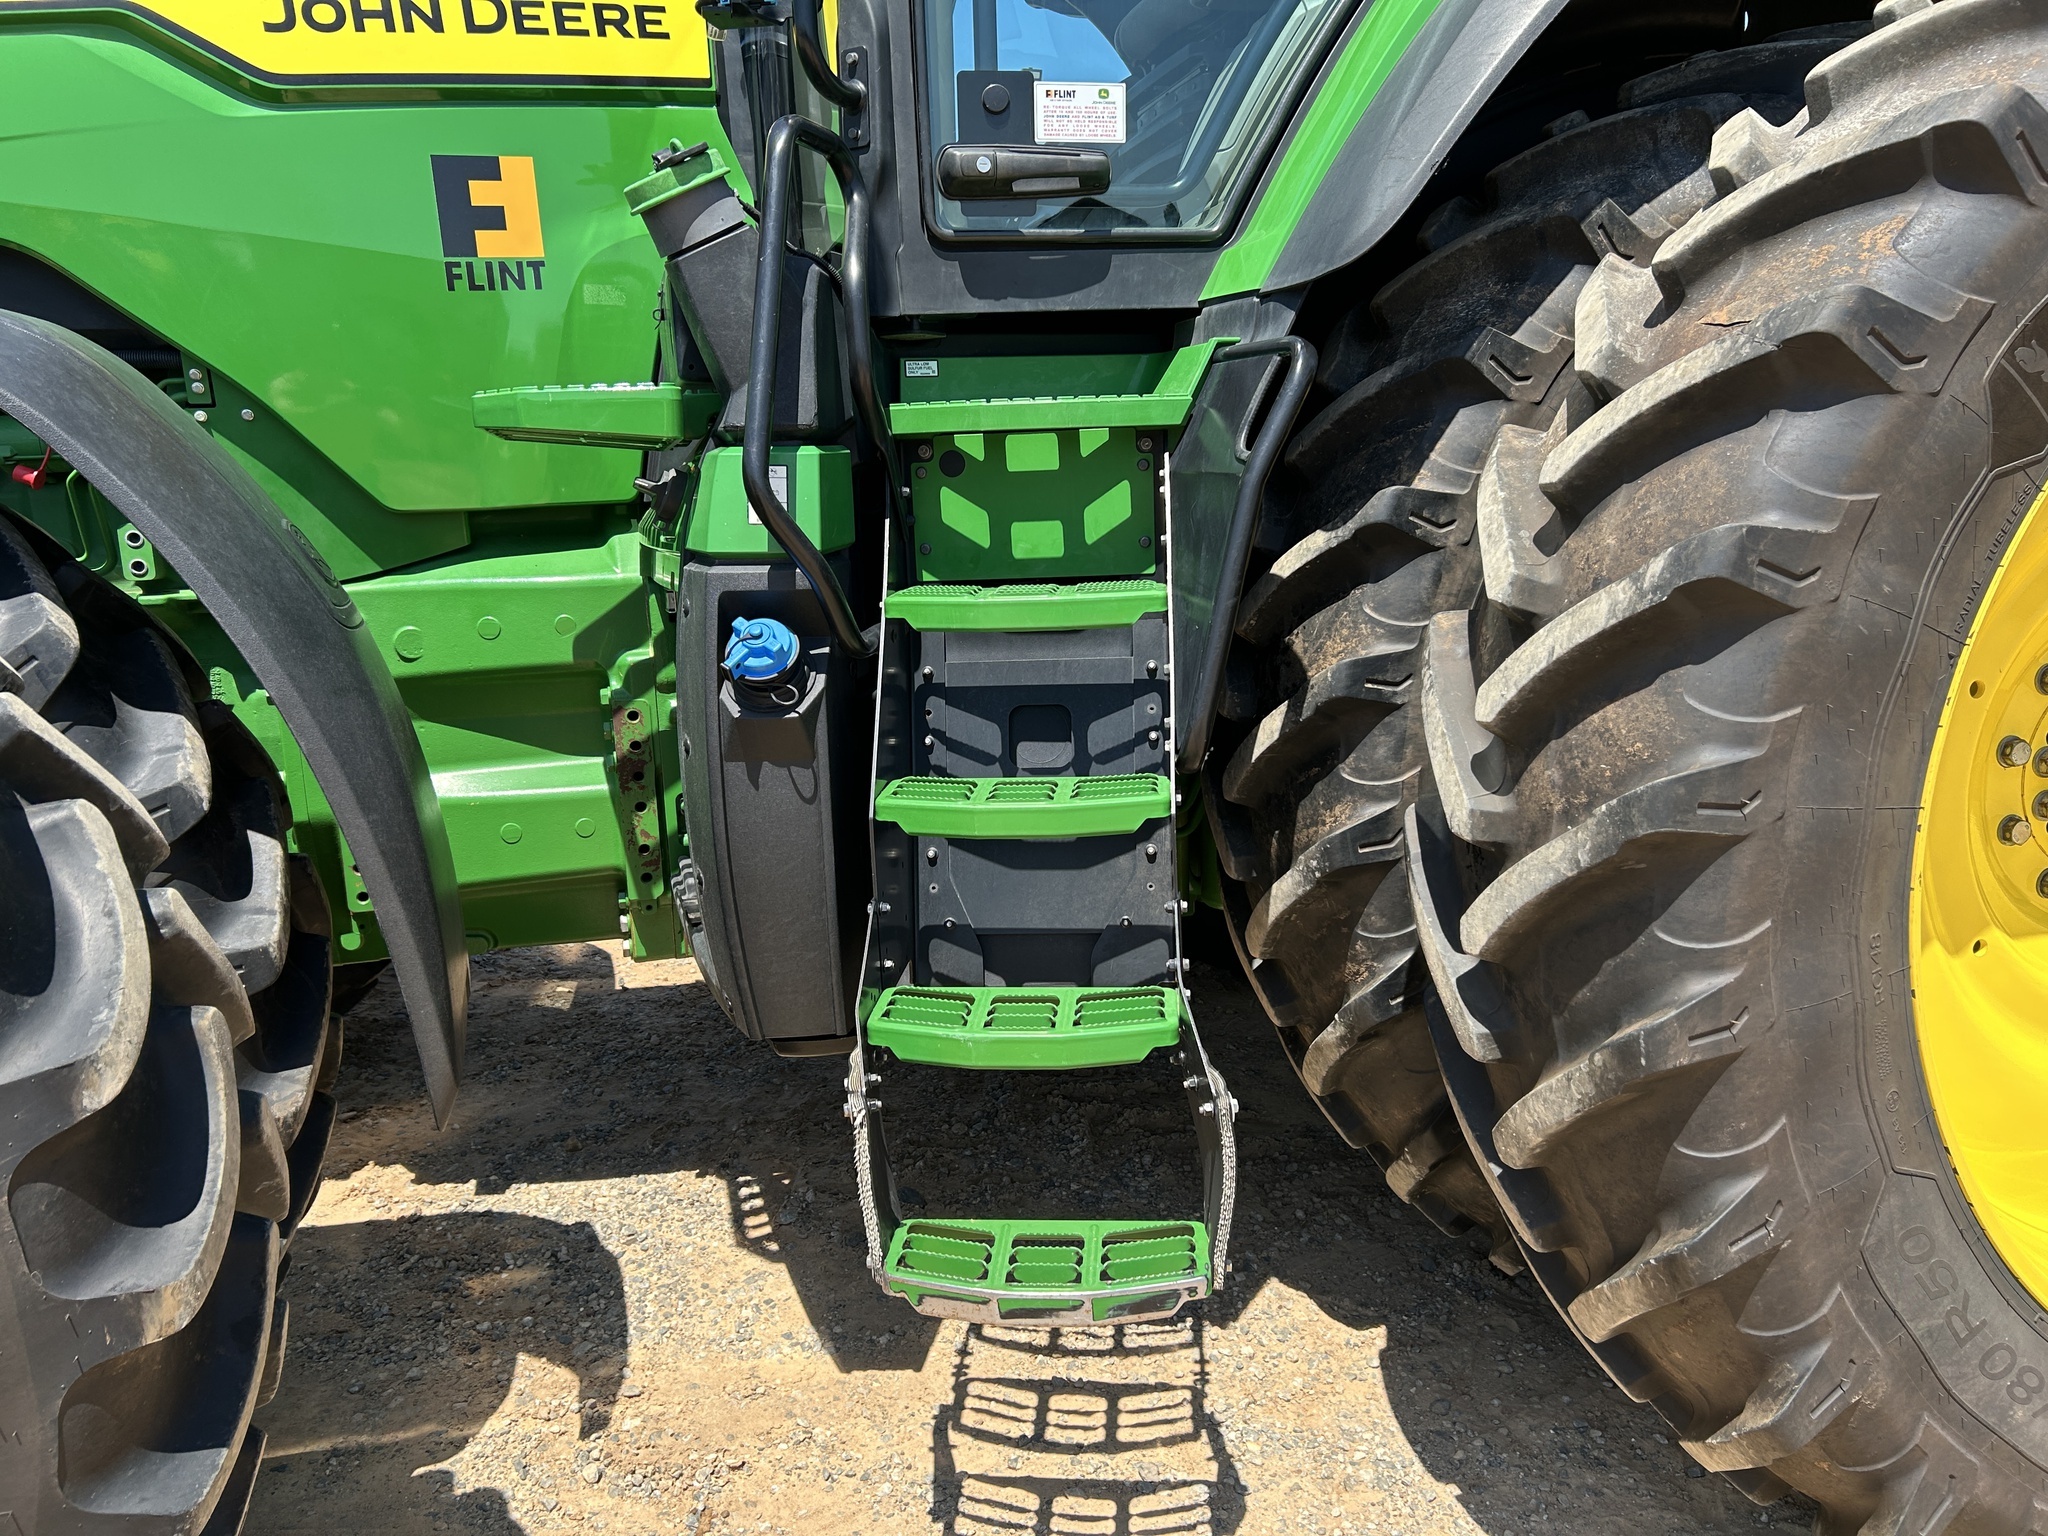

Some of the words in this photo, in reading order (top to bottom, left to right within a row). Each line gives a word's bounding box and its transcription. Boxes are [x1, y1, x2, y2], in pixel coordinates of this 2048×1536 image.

[262, 0, 446, 34] JOHN
[462, 0, 672, 40] DEERE
[1054, 90, 1076, 98] FLINT
[445, 259, 546, 292] FLINT
[1954, 577, 1983, 634] RADIAL
[1984, 483, 2032, 562] TUBELESS
